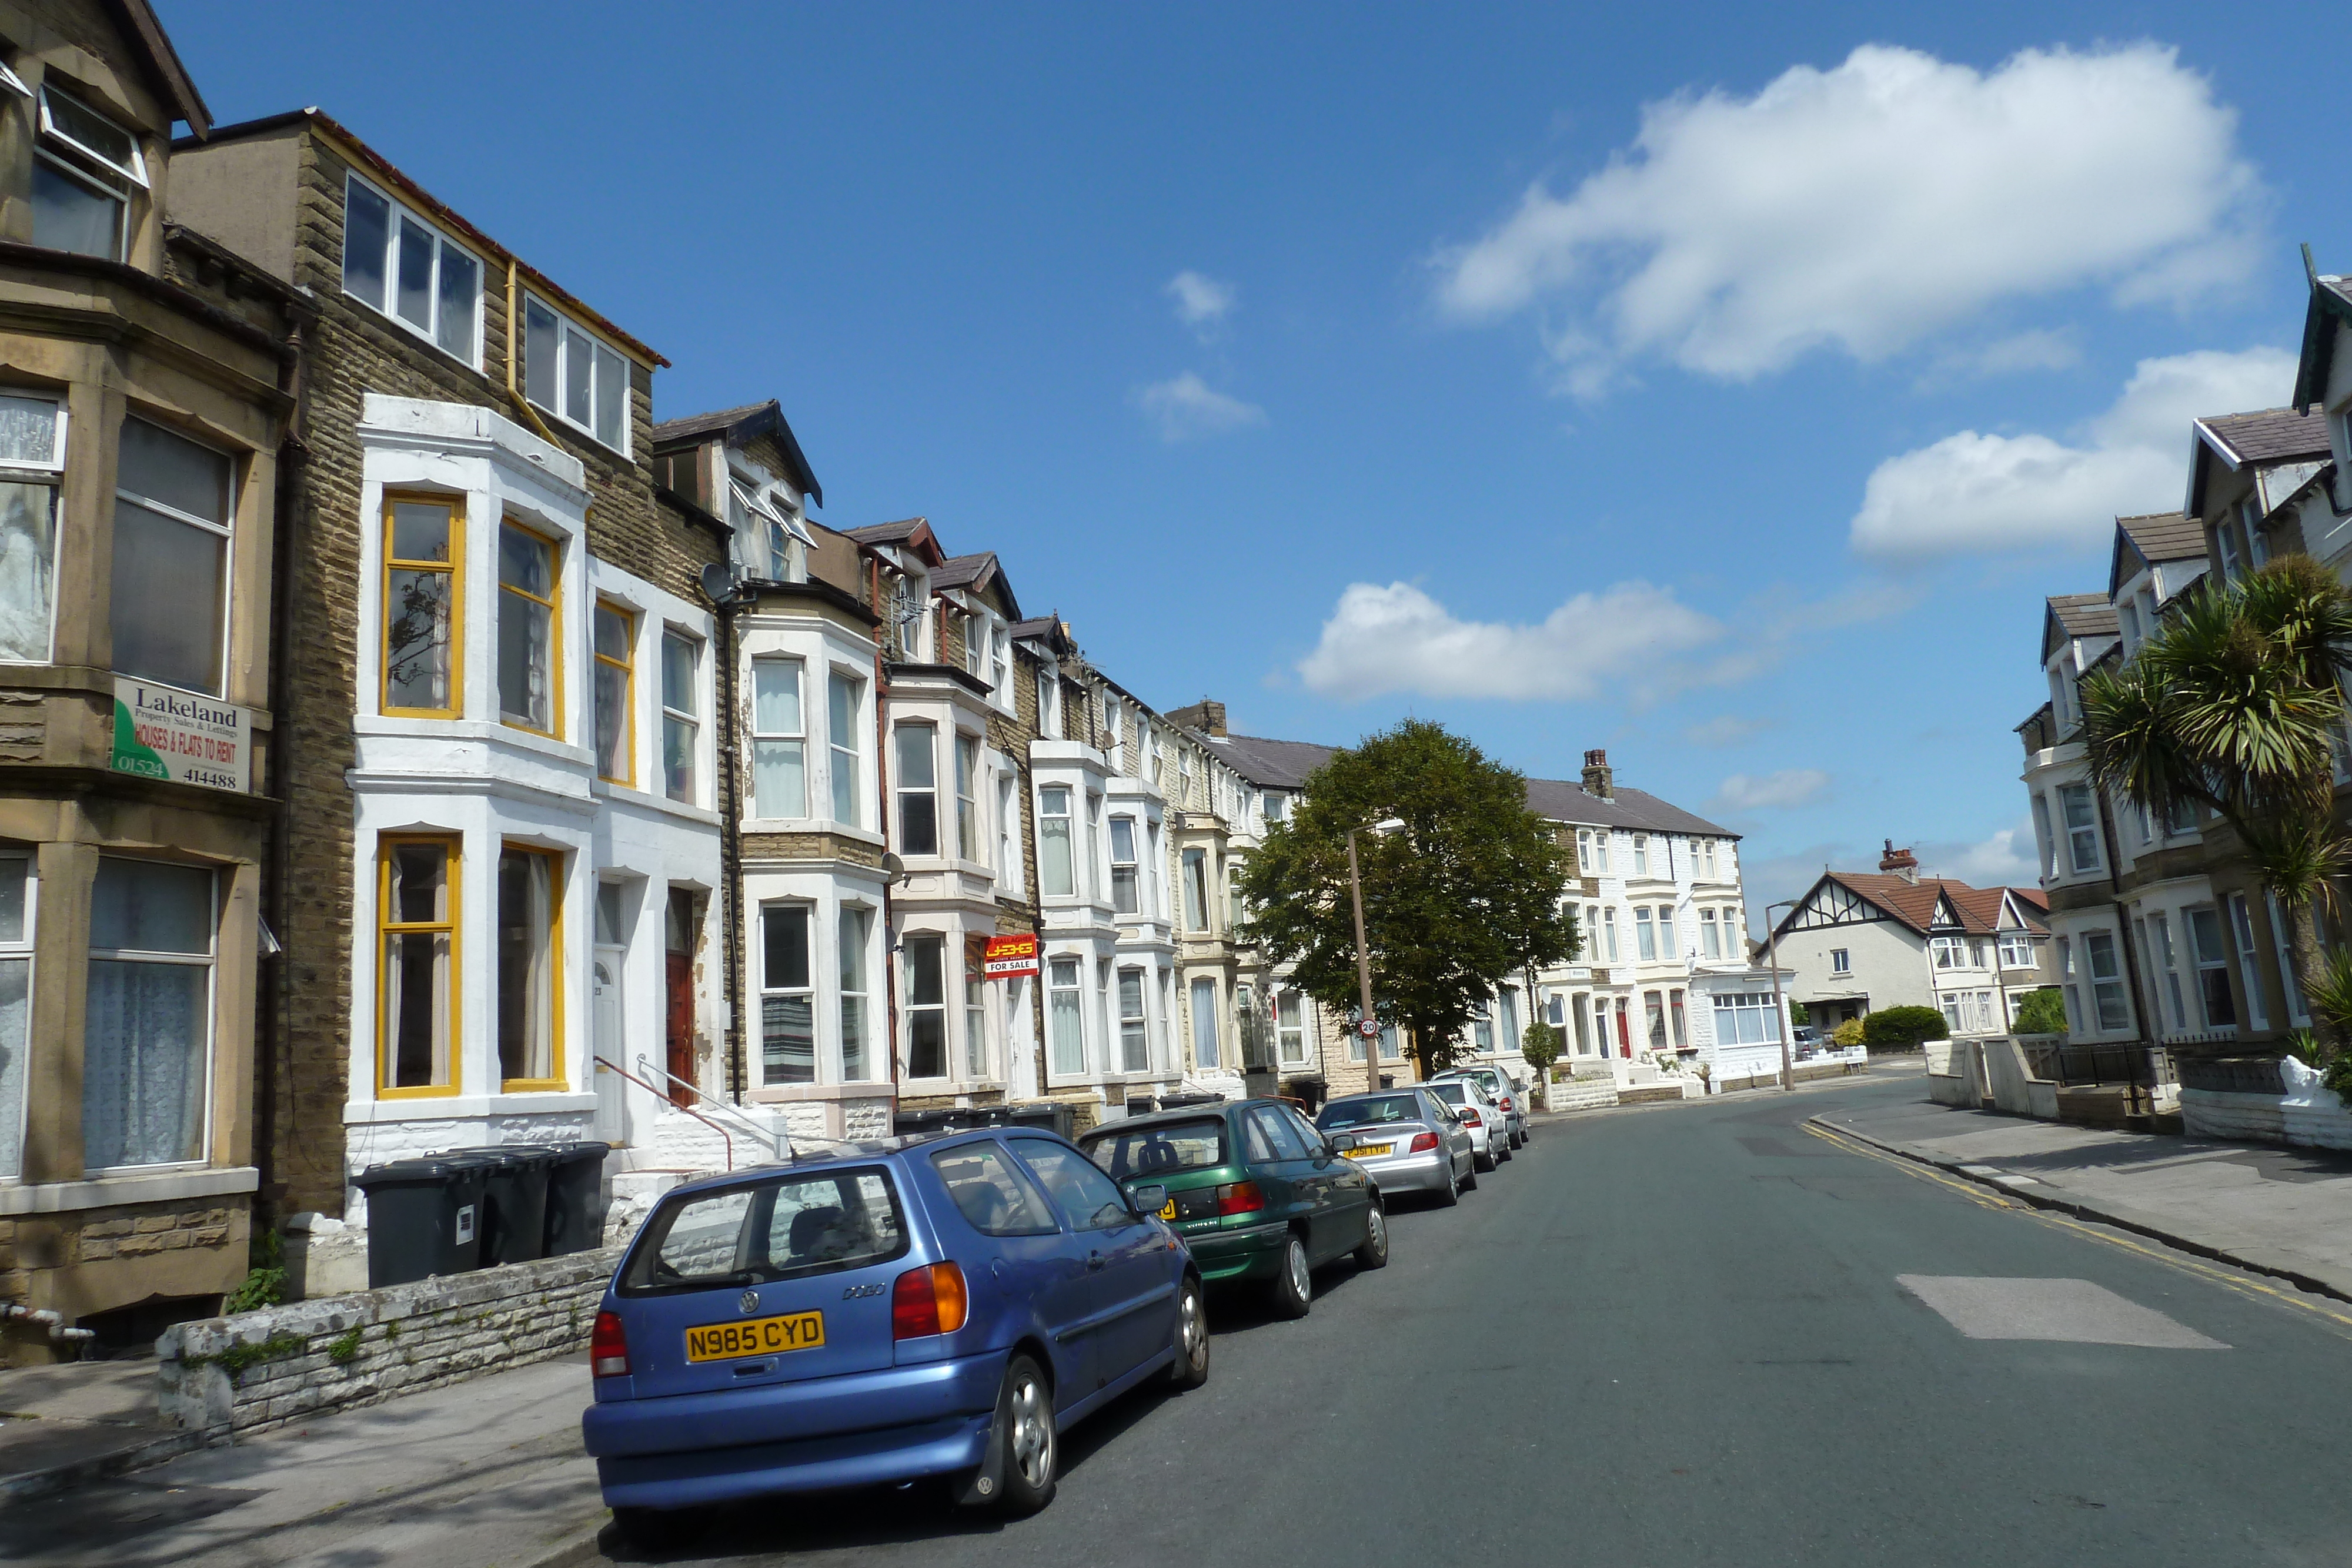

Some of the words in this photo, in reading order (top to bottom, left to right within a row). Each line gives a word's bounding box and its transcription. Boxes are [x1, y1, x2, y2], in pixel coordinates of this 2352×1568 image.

[135, 687, 237, 727] Lakeland
[135, 708, 171, 726] Property
[174, 718, 195, 729] Sales
[207, 723, 238, 738] Lettings
[135, 723, 168, 750] HOUSES
[171, 731, 175, 752] &
[179, 732, 202, 757] FLATS
[205, 738, 215, 760] TO
[216, 740, 236, 764] RENT
[118, 756, 163, 776] 01524
[183, 769, 236, 789] 414488
[994, 936, 1033, 944] GALLAGHER
[991, 963, 1006, 971] FOR
[1010, 961, 1030, 969] SALE
[690, 1325, 757, 1356] N985
[764, 1317, 819, 1348] CYD
